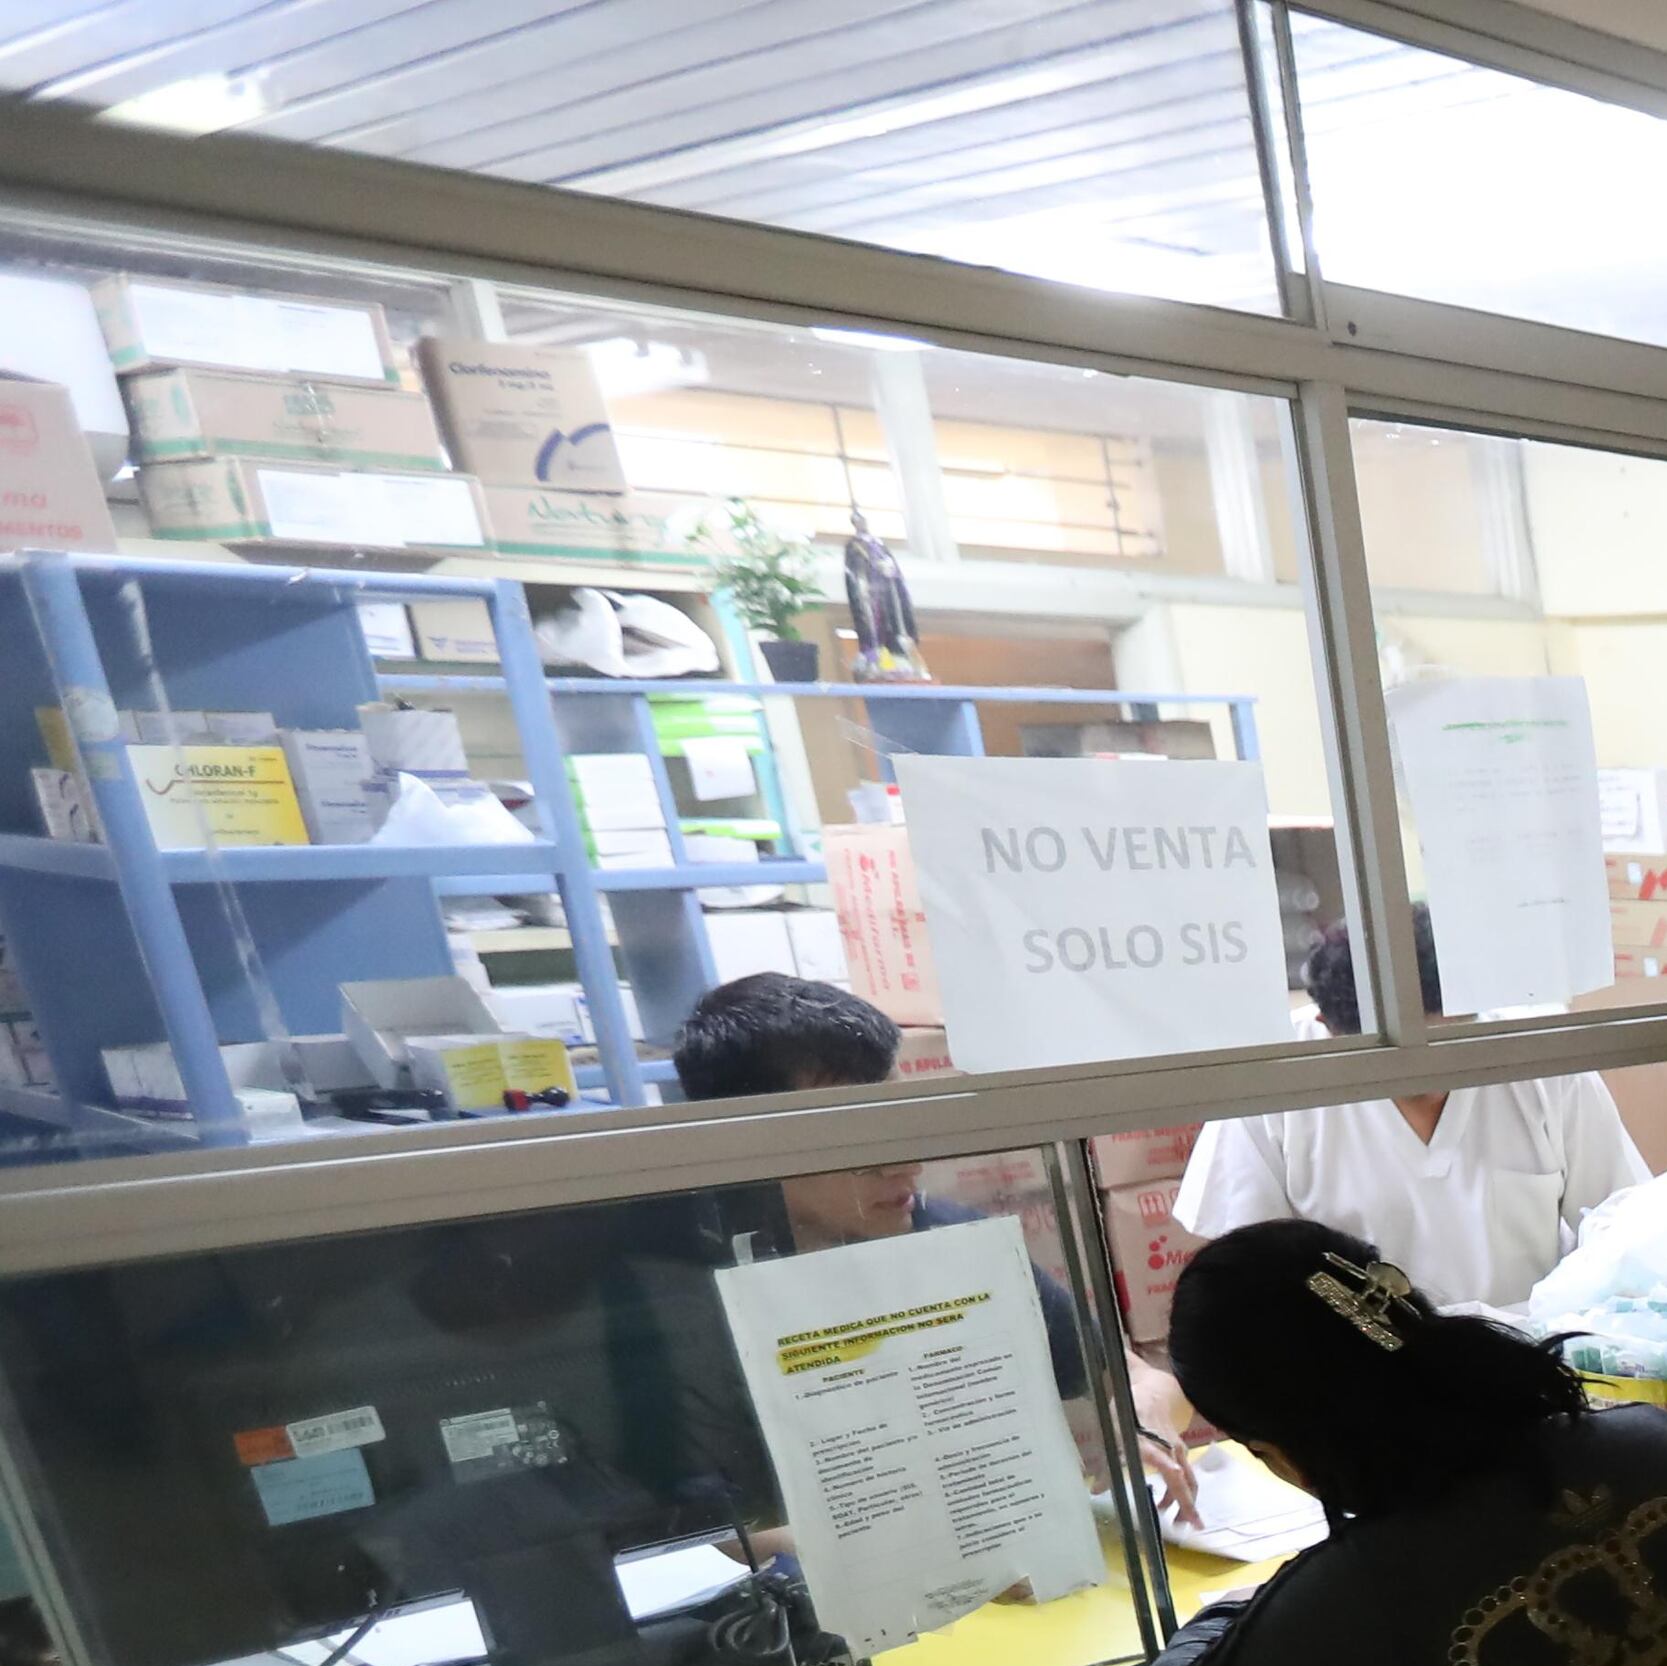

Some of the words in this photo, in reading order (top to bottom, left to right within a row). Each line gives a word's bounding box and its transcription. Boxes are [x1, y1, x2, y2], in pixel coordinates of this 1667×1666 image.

[981, 826, 1067, 873] NO
[1080, 826, 1256, 871] VENTA
[1022, 924, 1164, 973] SOLO
[1180, 921, 1248, 966] SIS
[777, 1331, 820, 1347] RECETA
[823, 1320, 864, 1337] MEDICA
[866, 1315, 887, 1327] QUE
[889, 1311, 906, 1322] NO
[908, 1302, 951, 1317] CUENTA
[954, 1296, 976, 1307] CON
[977, 1293, 990, 1302] LA
[782, 1340, 840, 1360] SIGUIENTE
[843, 1323, 914, 1346] INFORMACION
[917, 1319, 934, 1329] NO
[935, 1312, 964, 1326] SERA
[786, 1355, 841, 1374] ATENDIDA
[822, 1368, 864, 1382] PACIENTE
